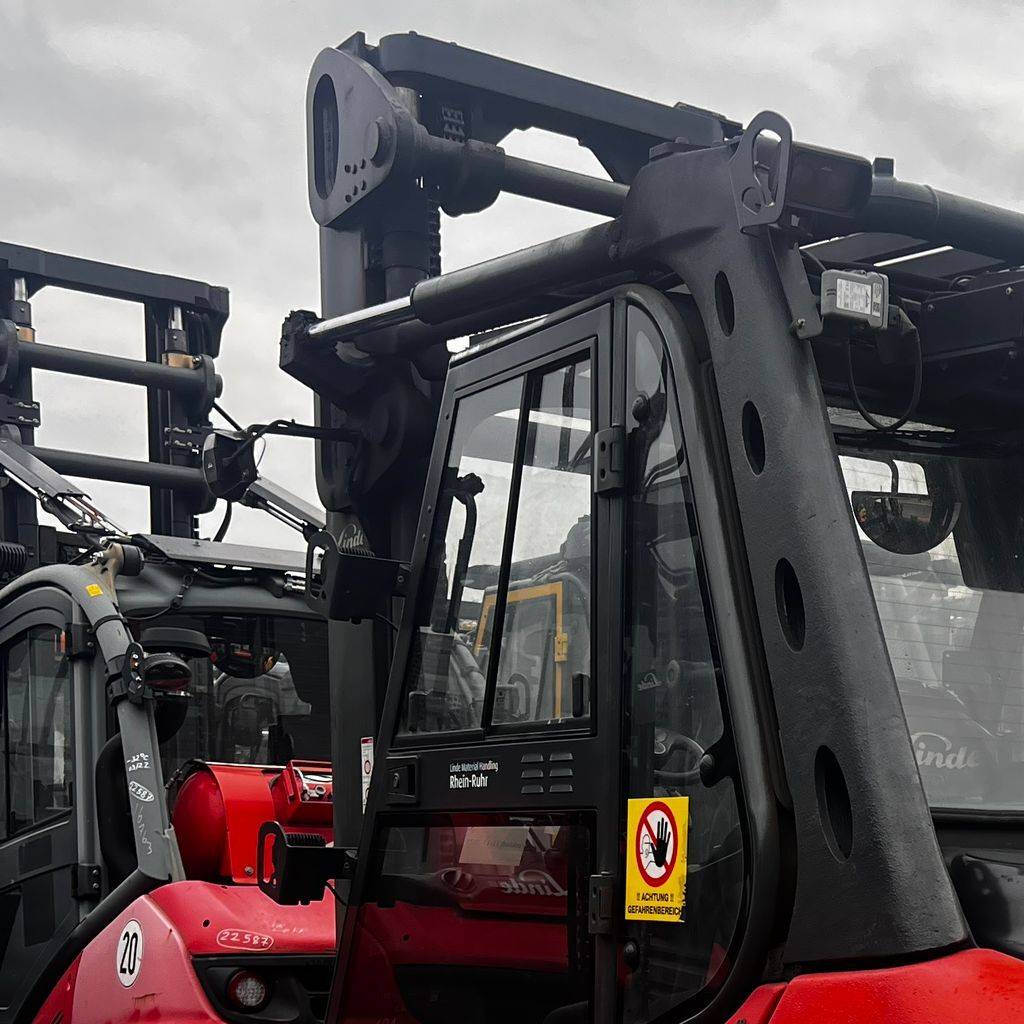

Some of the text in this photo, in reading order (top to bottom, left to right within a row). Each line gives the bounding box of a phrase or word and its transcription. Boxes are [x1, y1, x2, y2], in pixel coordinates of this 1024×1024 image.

[449, 760, 499, 772] Linde Material Handling
[449, 773, 488, 789] Rhein-Ruhr
[641, 893, 669, 902] ACHTUNG
[627, 905, 682, 915] GEFAHRENBEREICH
[219, 931, 270, 947] 22587
[119, 931, 138, 975] 20
